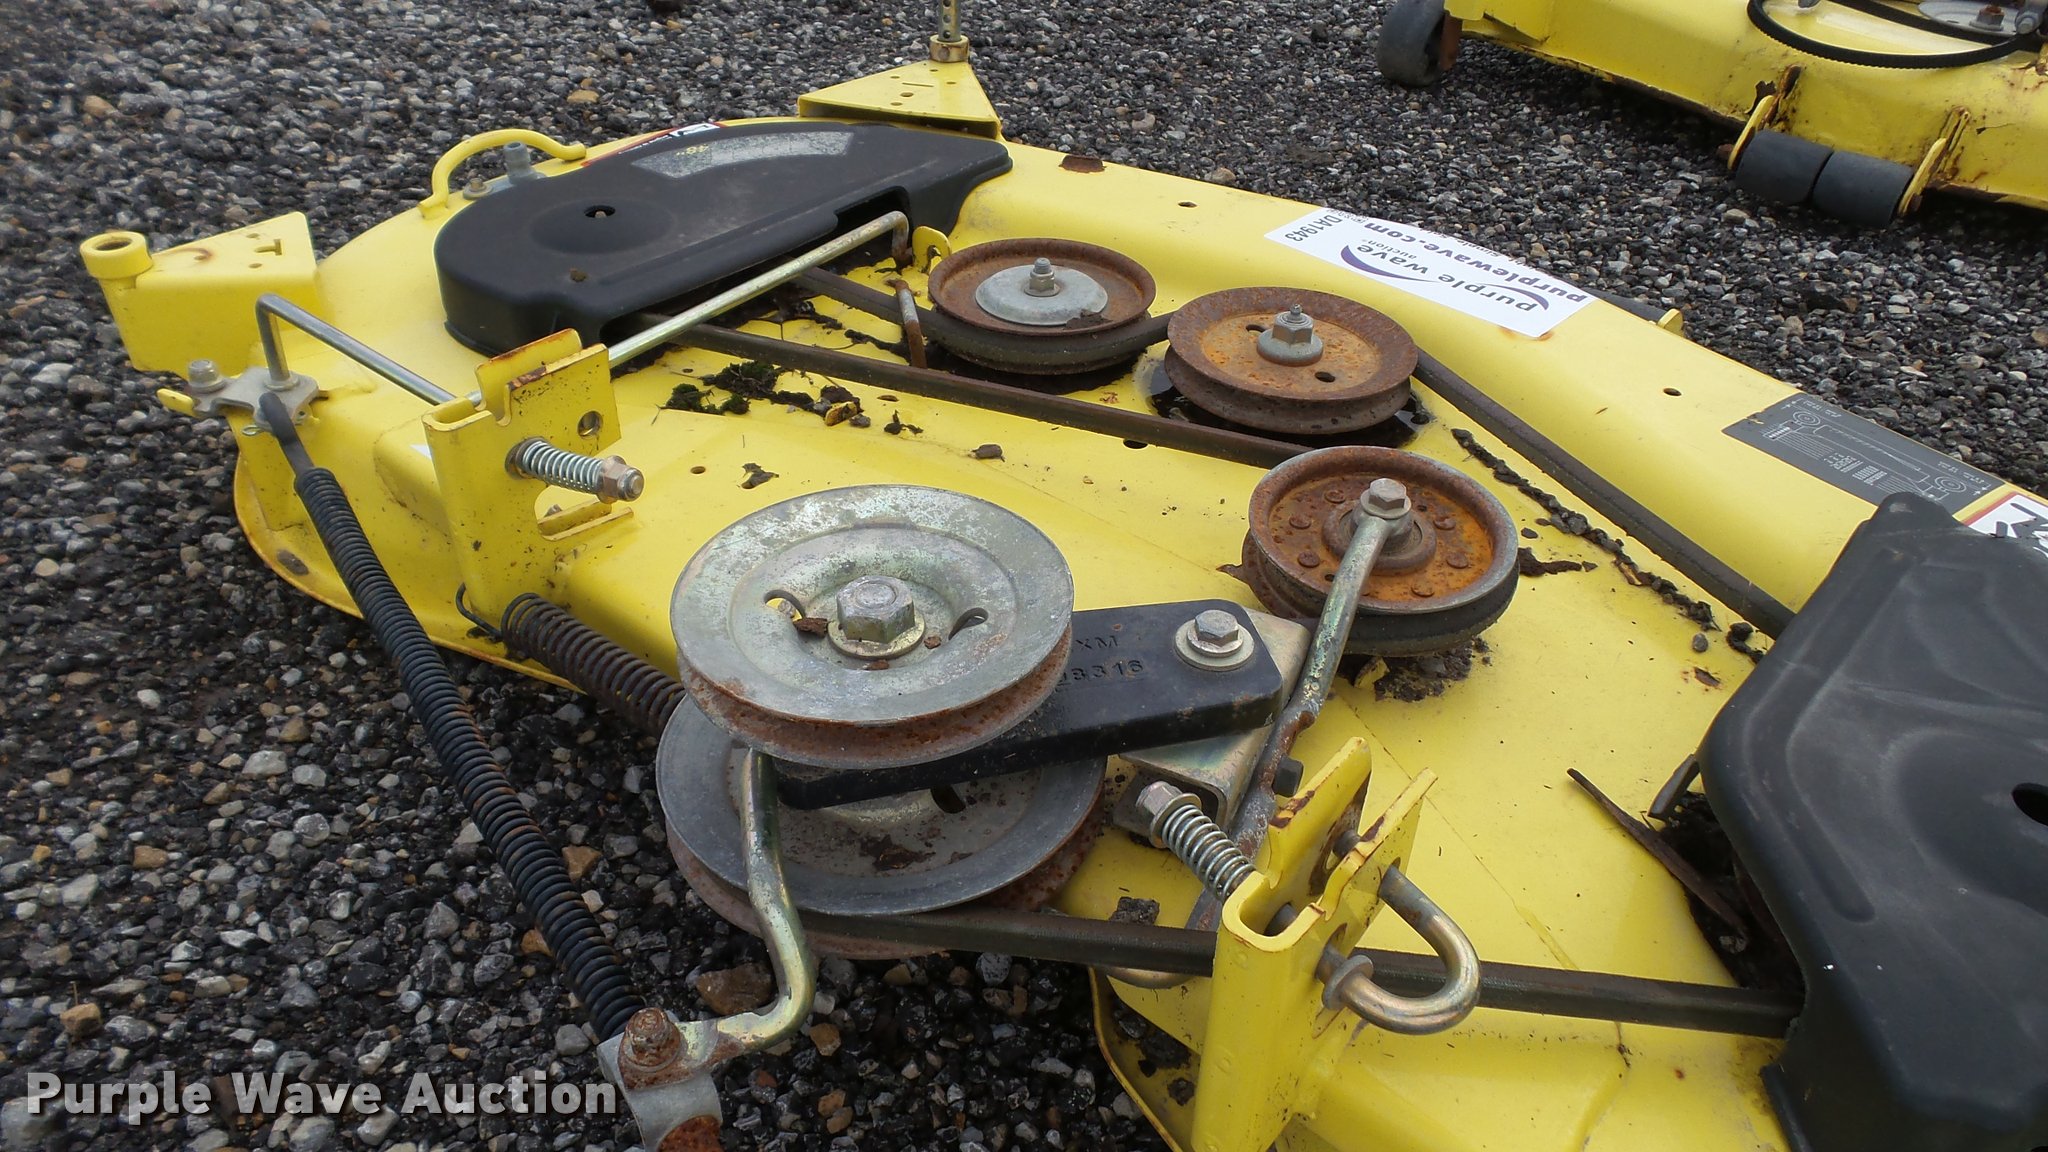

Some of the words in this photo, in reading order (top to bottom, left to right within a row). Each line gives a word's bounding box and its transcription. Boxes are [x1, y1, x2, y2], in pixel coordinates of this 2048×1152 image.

[1284, 215, 1343, 243] DA1943
[1356, 243, 1428, 275] wave
[1363, 221, 1588, 303] purplewave.com
[1437, 272, 1538, 312] purple
